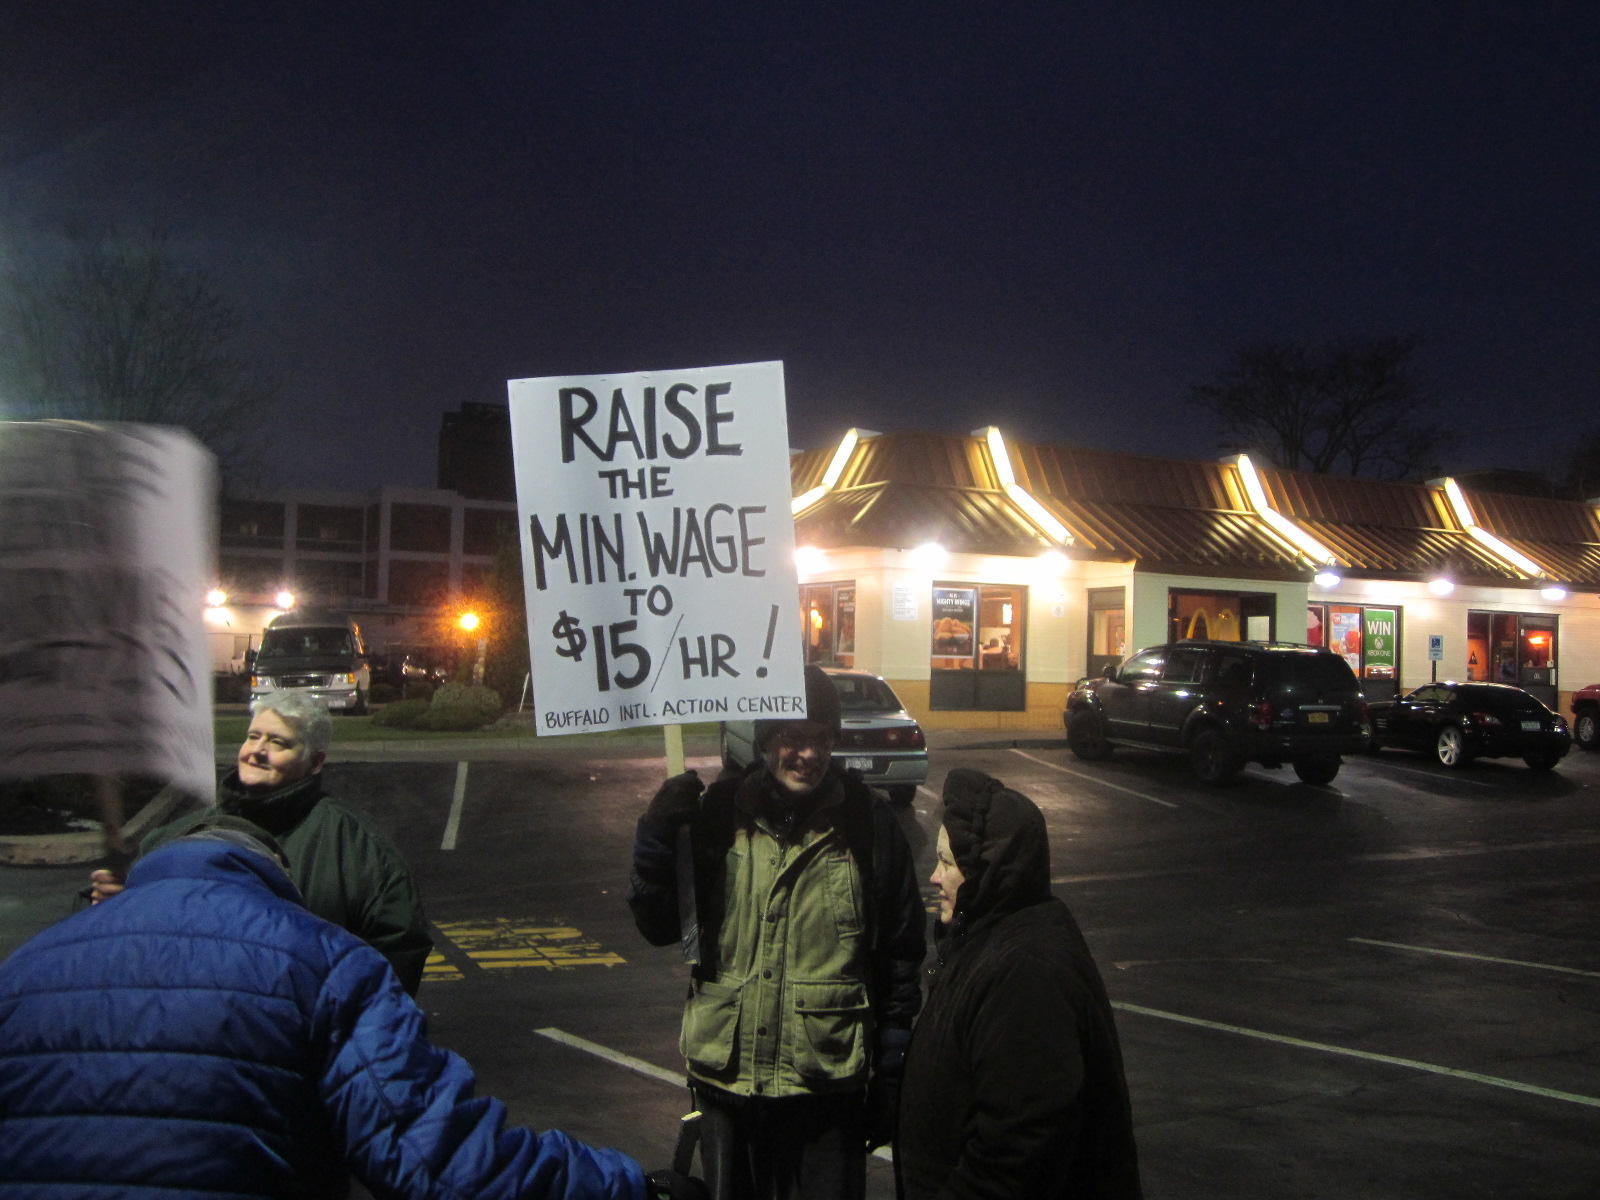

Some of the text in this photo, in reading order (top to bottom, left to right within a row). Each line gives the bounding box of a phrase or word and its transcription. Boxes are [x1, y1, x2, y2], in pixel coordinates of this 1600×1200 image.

[558, 381, 743, 463] RAISE
[598, 466, 674, 499] THE
[623, 584, 674, 616] TO
[1367, 620, 1391, 636] WIN
[545, 696, 805, 729] BUFFALO INTL. ACTION CENTER
